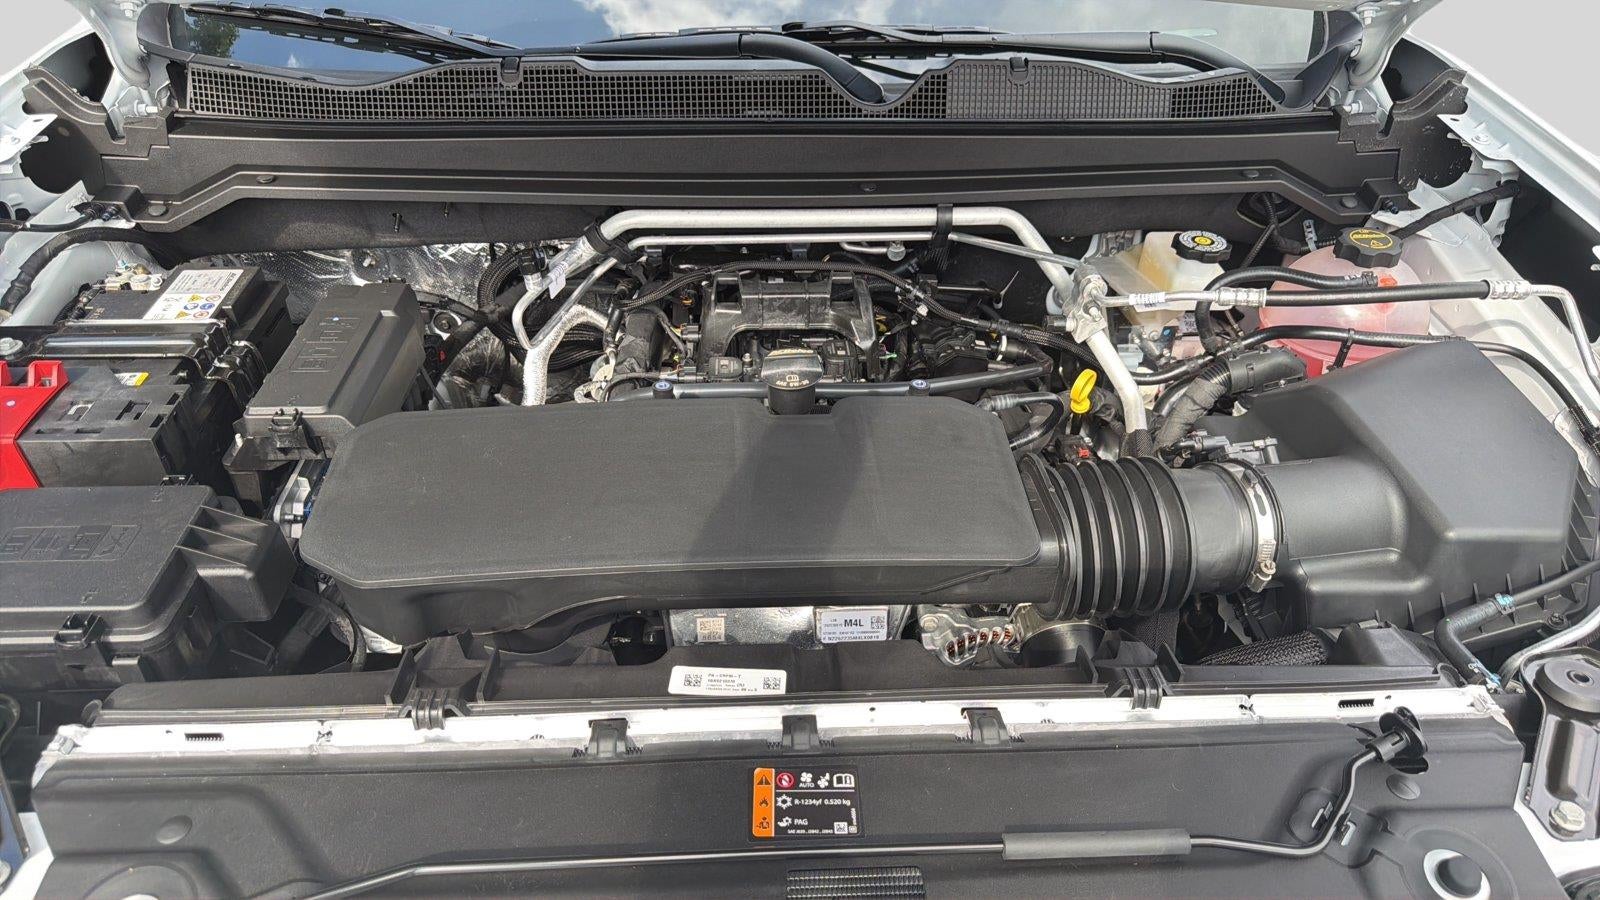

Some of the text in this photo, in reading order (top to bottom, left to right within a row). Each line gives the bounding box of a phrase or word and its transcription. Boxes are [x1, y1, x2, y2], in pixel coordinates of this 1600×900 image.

[844, 619, 864, 627] M4L
[794, 798, 822, 806] R-1234yf
[843, 798, 851, 806] kg
